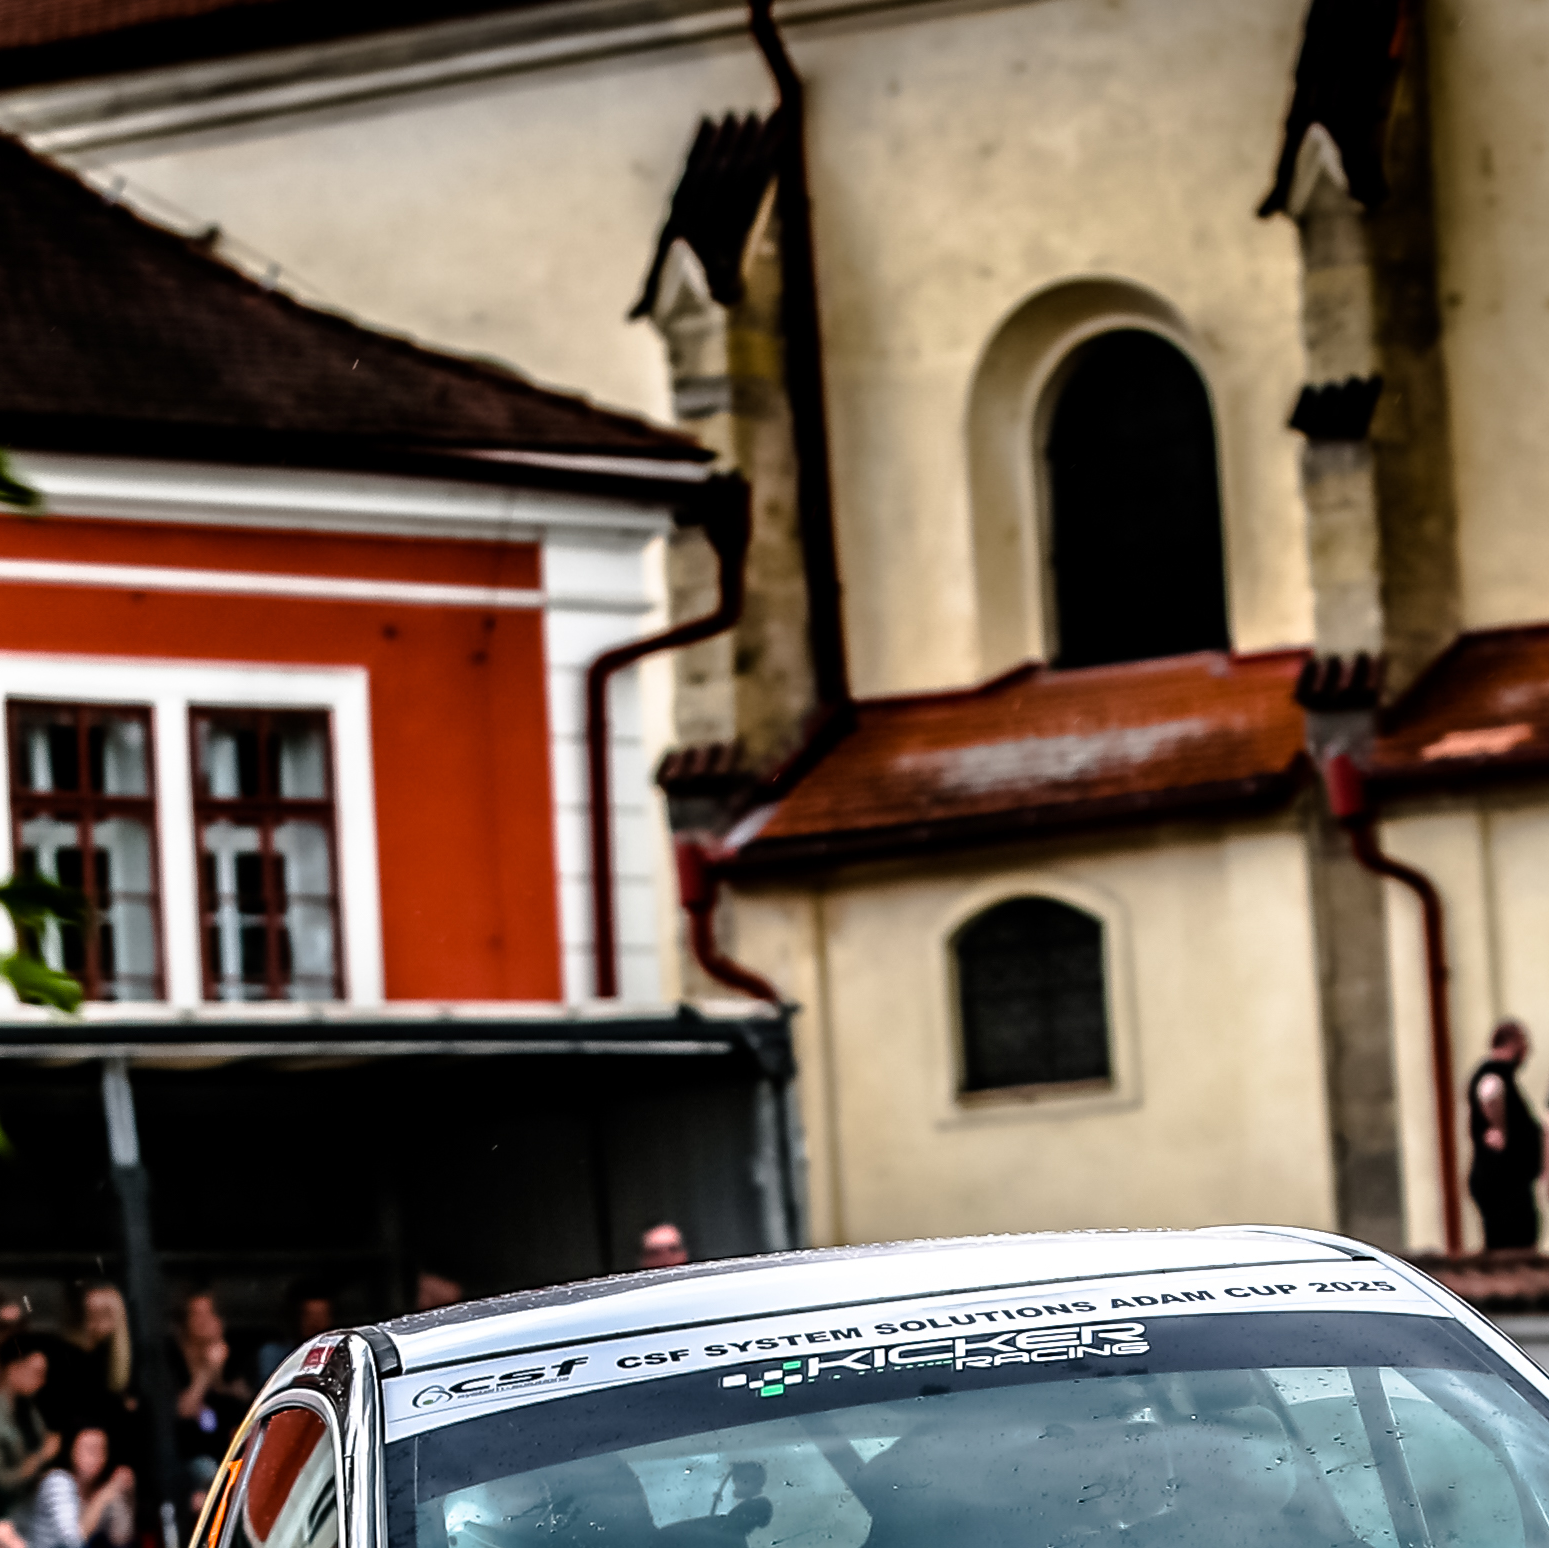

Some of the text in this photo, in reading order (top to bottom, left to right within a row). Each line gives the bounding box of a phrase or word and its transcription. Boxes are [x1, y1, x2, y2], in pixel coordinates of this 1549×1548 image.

[616, 1280, 1397, 1369] CSF SYSTEM SOLUTIONS ADAM CUP 2025
[807, 1321, 1147, 1378] KICKER
[954, 1341, 1150, 1372] RACING
